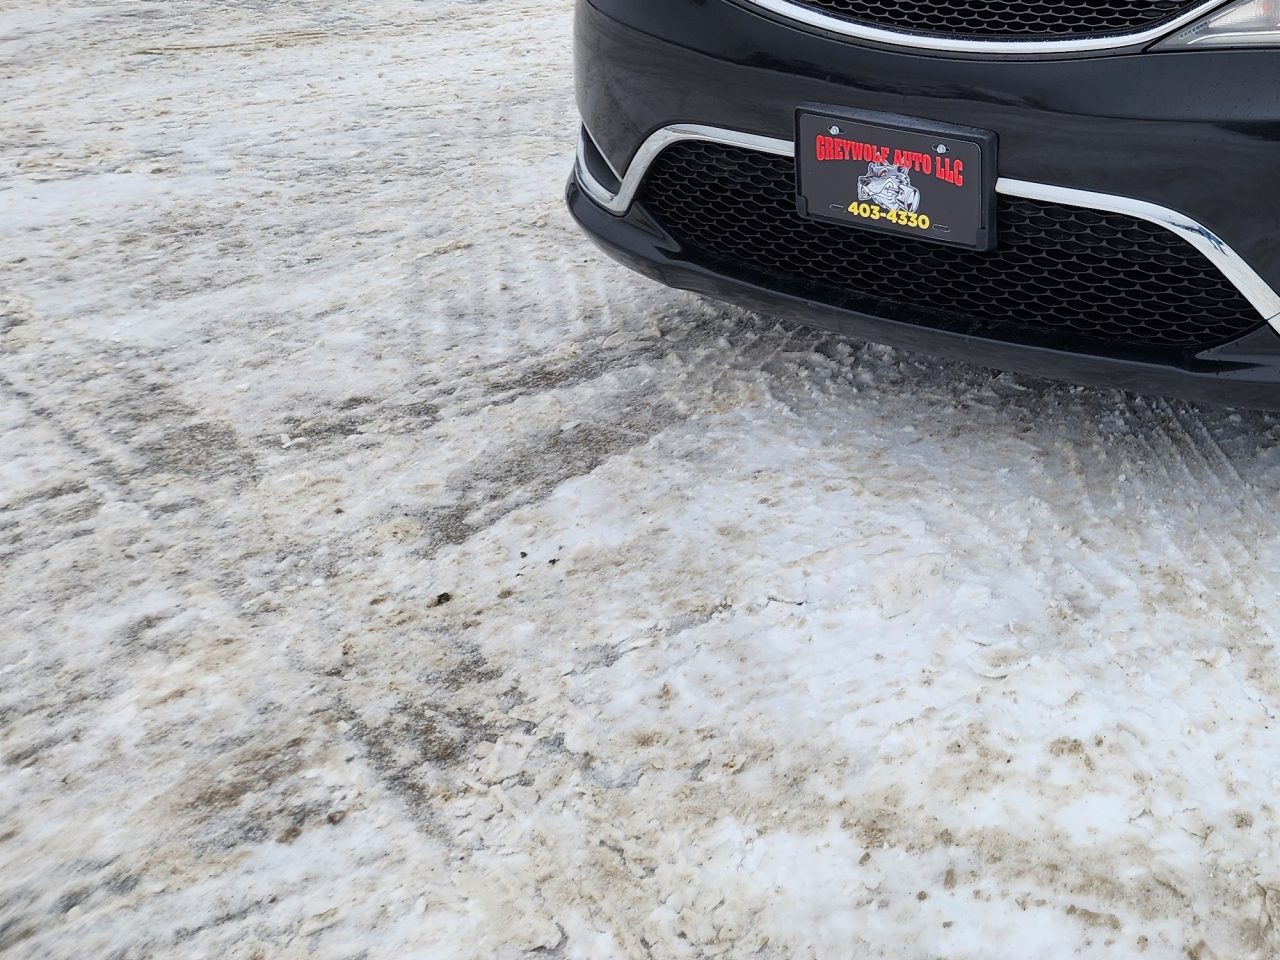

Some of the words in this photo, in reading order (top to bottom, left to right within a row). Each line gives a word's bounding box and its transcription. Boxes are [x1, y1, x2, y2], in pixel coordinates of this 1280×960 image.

[815, 134, 890, 163] GREYWOLF
[893, 149, 932, 175] AUTO
[934, 156, 964, 187] LLC
[847, 201, 930, 230] 403-4330
